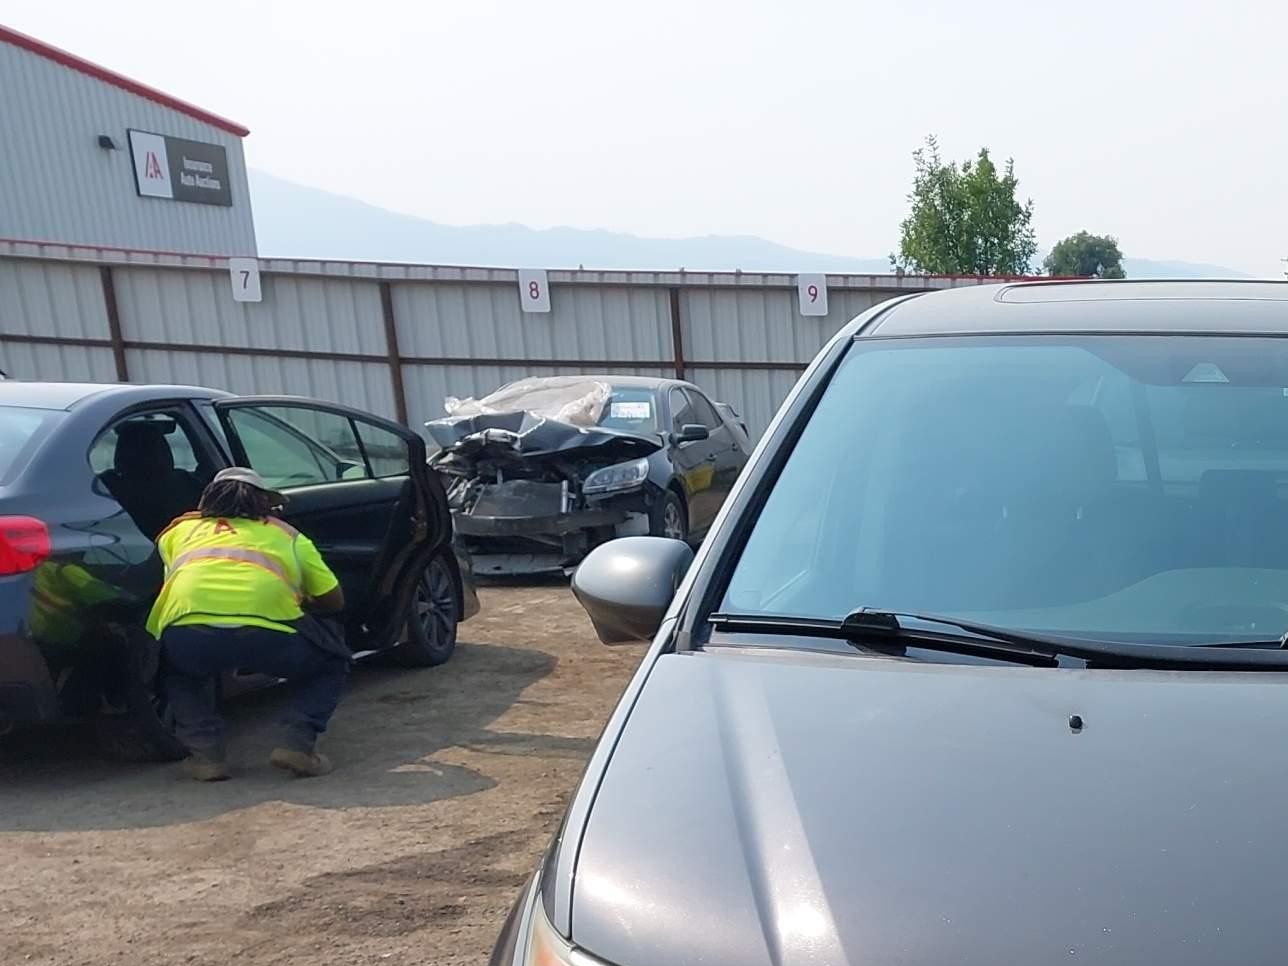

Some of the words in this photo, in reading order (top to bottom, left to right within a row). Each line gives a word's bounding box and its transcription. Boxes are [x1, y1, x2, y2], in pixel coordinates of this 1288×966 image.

[239, 270, 250, 289] 7
[528, 281, 540, 300] 8
[807, 285, 818, 303] 9
